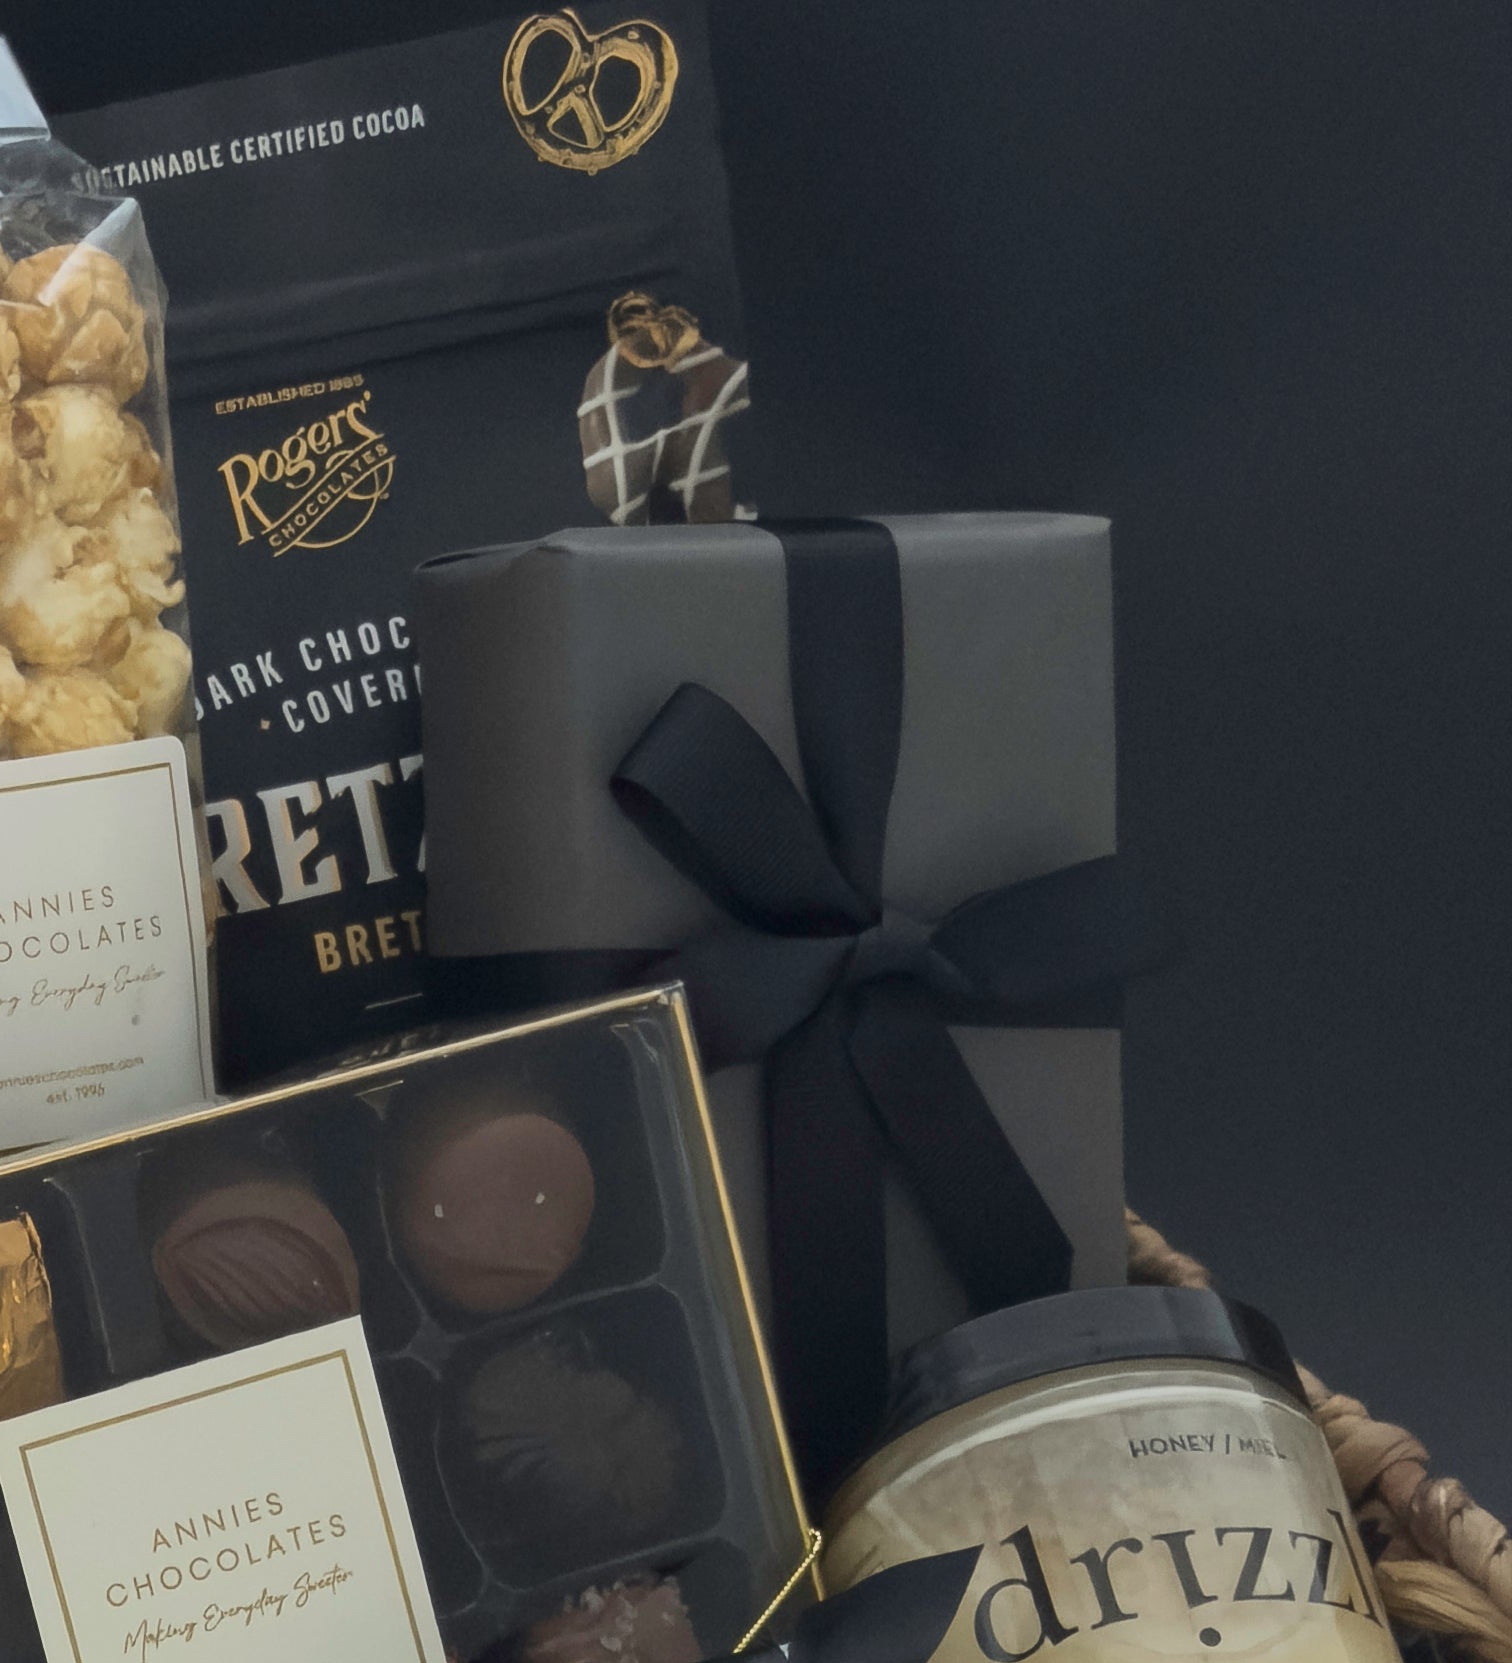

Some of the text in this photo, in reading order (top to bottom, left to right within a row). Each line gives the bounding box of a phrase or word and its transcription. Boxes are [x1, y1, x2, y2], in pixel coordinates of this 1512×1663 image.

[230, 119, 345, 164] CERTIFIED
[353, 103, 425, 141] COCOA
[215, 382, 325, 415] ESTABLISHED
[268, 443, 389, 548] CHOCOLATES
[299, 616, 410, 672] CHOC
[282, 663, 422, 733] COVER
[314, 910, 423, 974] BRET
[1128, 1433, 1215, 1458] HONEY
[152, 1492, 284, 1553] ANNIES
[106, 1514, 347, 1607] CHOCOLATES
